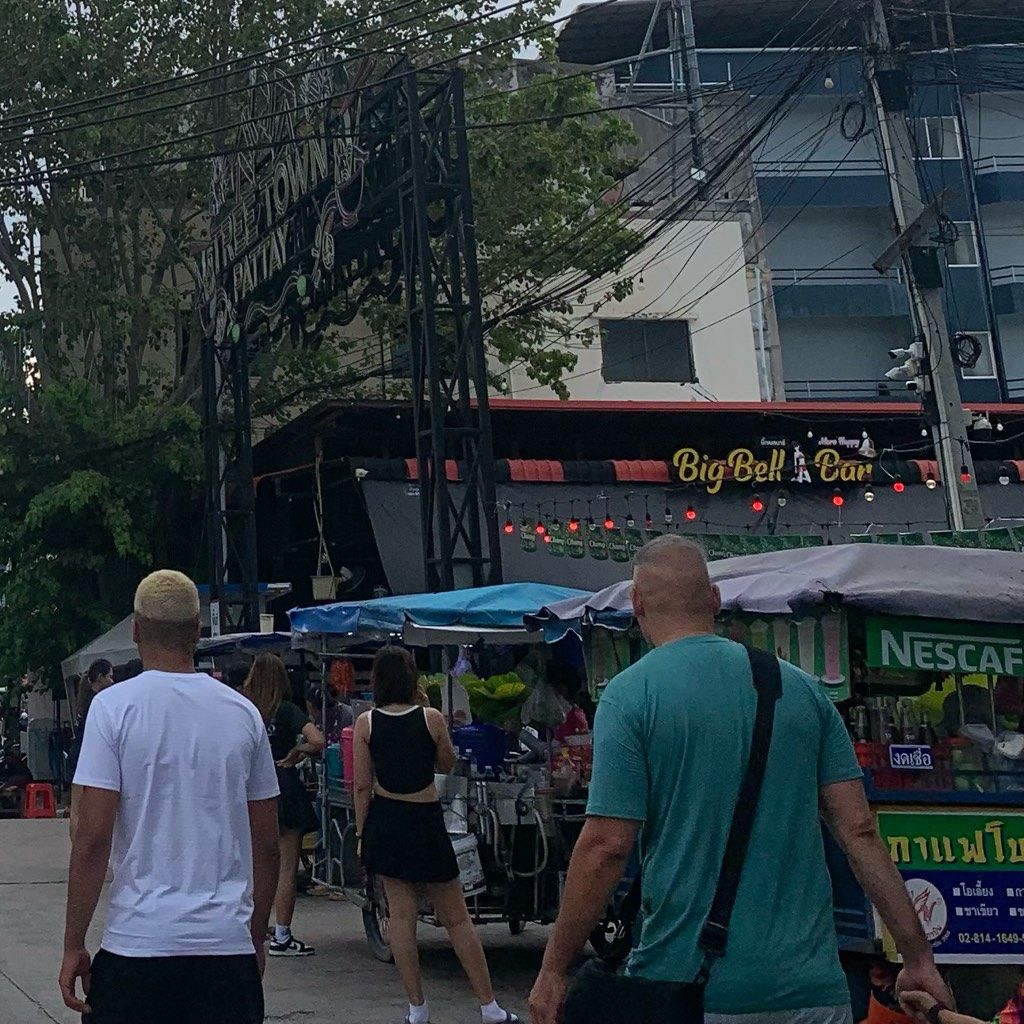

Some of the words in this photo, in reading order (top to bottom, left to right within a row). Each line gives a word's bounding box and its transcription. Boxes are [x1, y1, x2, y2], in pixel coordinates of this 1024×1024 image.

[258, 132, 328, 229] TOWN
[673, 447, 725, 494] Big
[727, 448, 786, 483] Bell
[814, 448, 873, 482] Bar
[892, 747, 932, 767] งดเชื่อ
